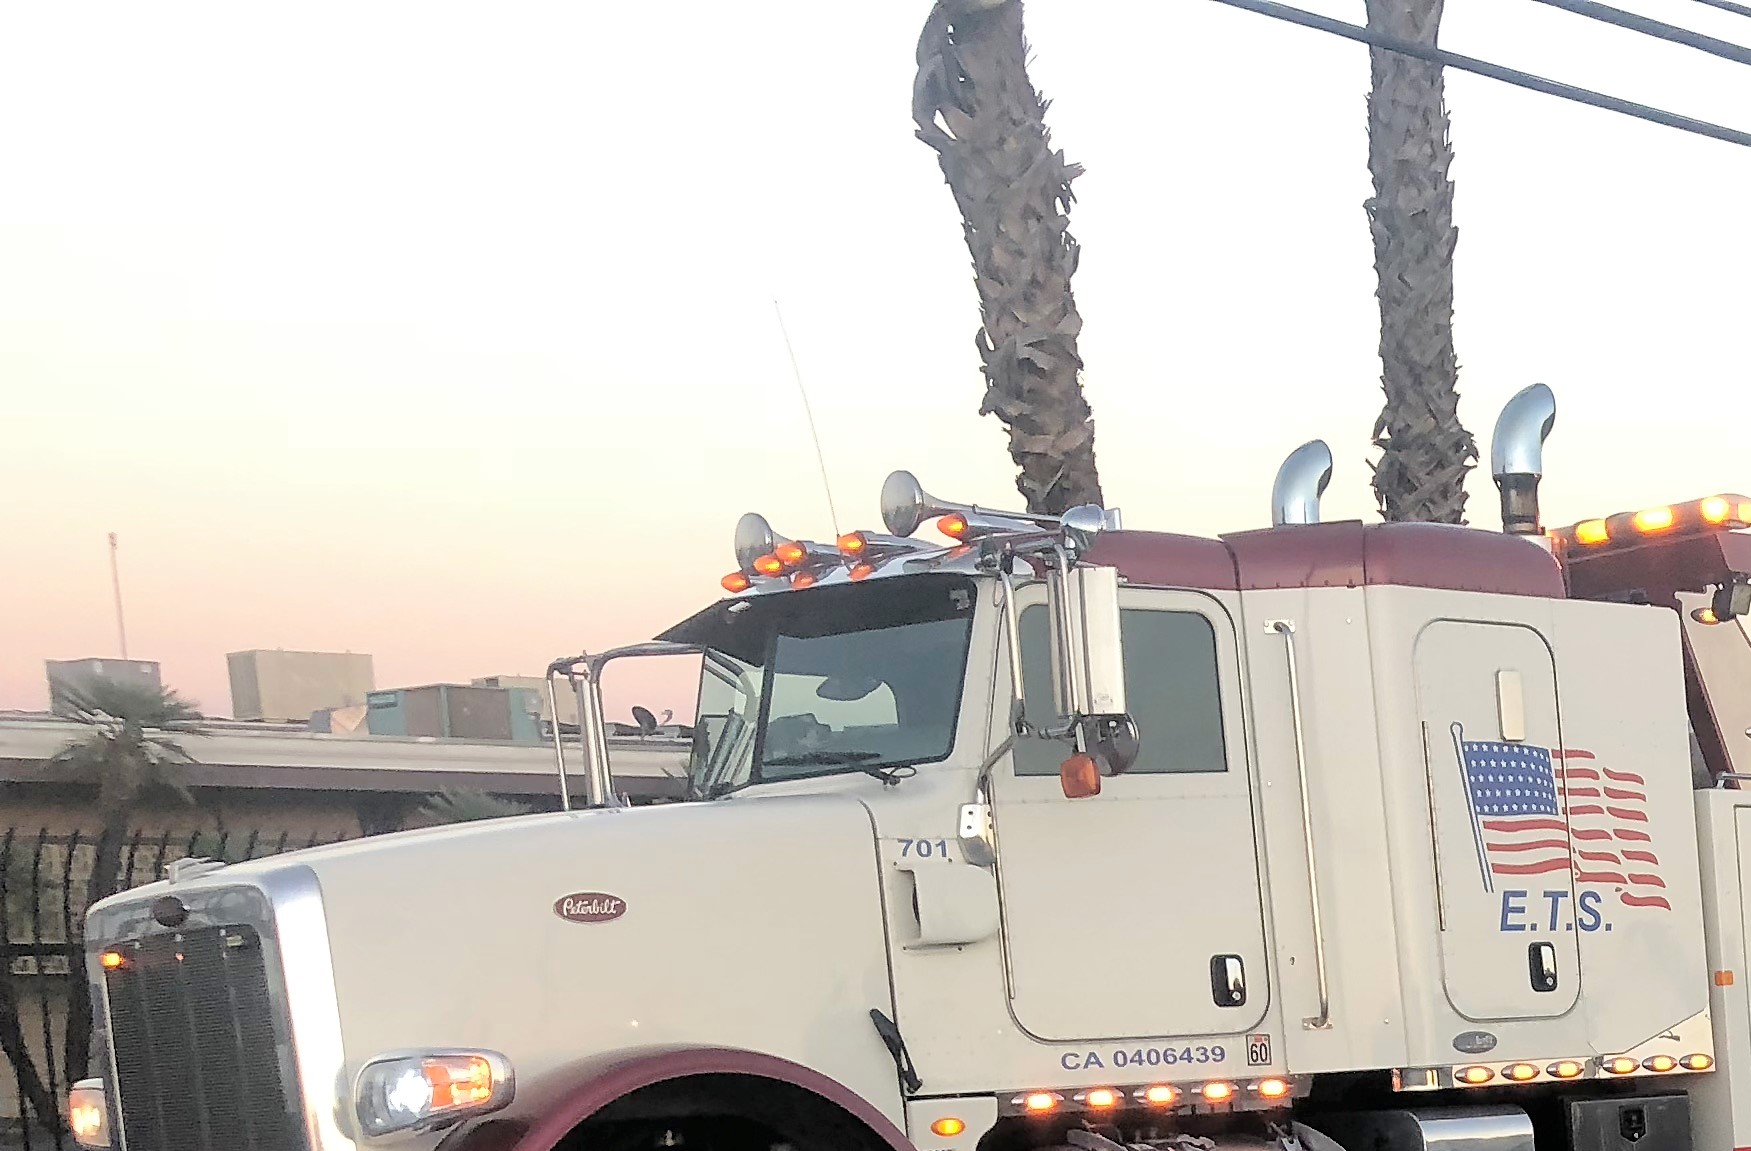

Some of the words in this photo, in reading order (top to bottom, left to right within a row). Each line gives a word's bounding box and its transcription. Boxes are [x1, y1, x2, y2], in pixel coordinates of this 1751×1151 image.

[897, 838, 947, 858] 701
[563, 898, 621, 916] Peterbilt
[1500, 890, 1612, 932] E.T.S.
[1061, 1051, 1105, 1070] CA
[1113, 1045, 1226, 1068] 0406439
[1250, 1042, 1268, 1063] 60
